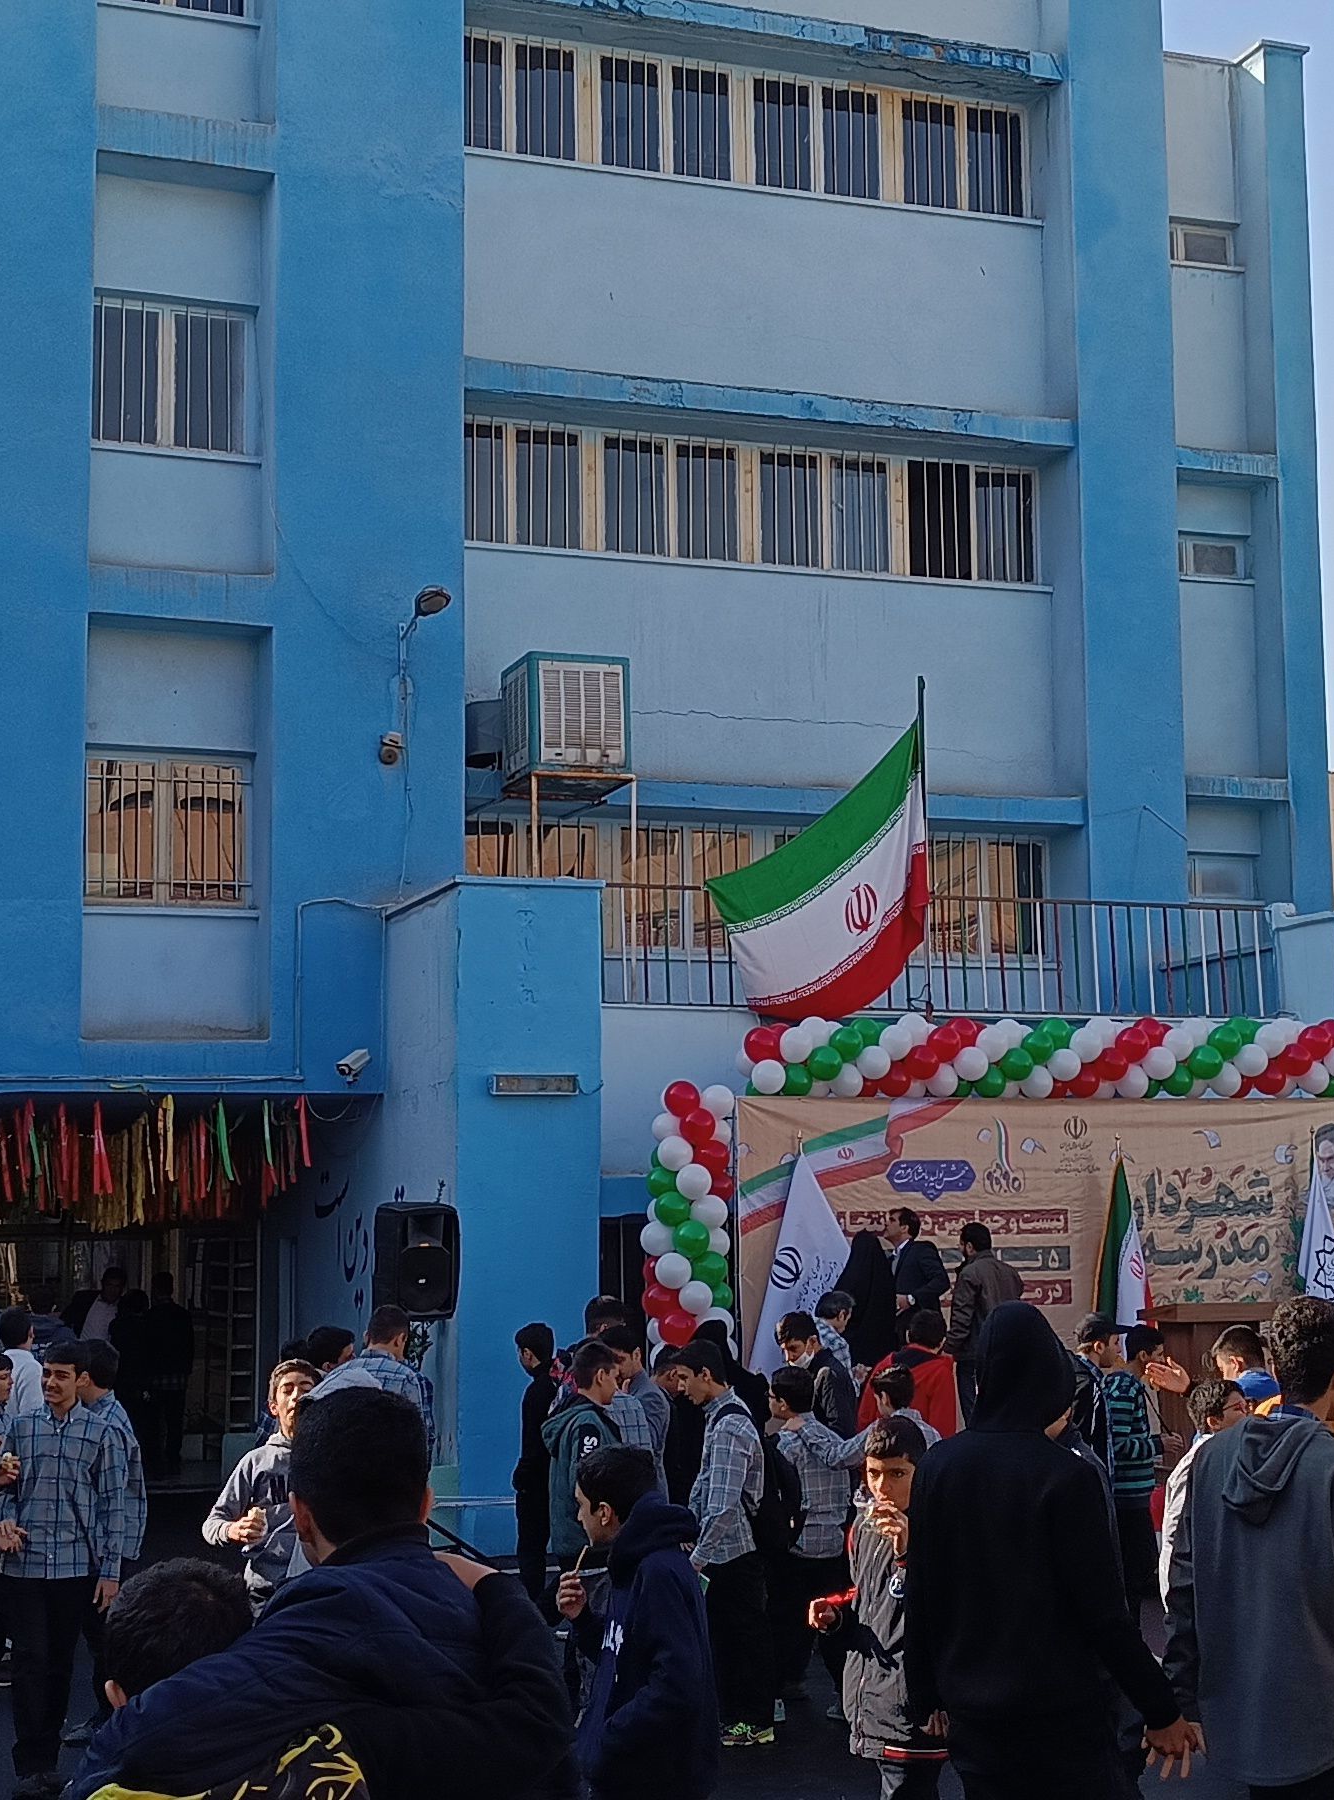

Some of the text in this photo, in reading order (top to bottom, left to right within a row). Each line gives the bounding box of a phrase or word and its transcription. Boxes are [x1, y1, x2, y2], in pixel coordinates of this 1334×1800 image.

[934, 1209, 1007, 1236] چهامین
[1008, 1217, 1018, 1235] و
[1019, 1213, 1065, 1235] بیست
[1048, 1248, 1060, 1269] ۵
[1142, 1221, 1271, 1281] مدرسه
[1043, 1283, 1063, 1305] در
[580, 1435, 599, 1458] Su
